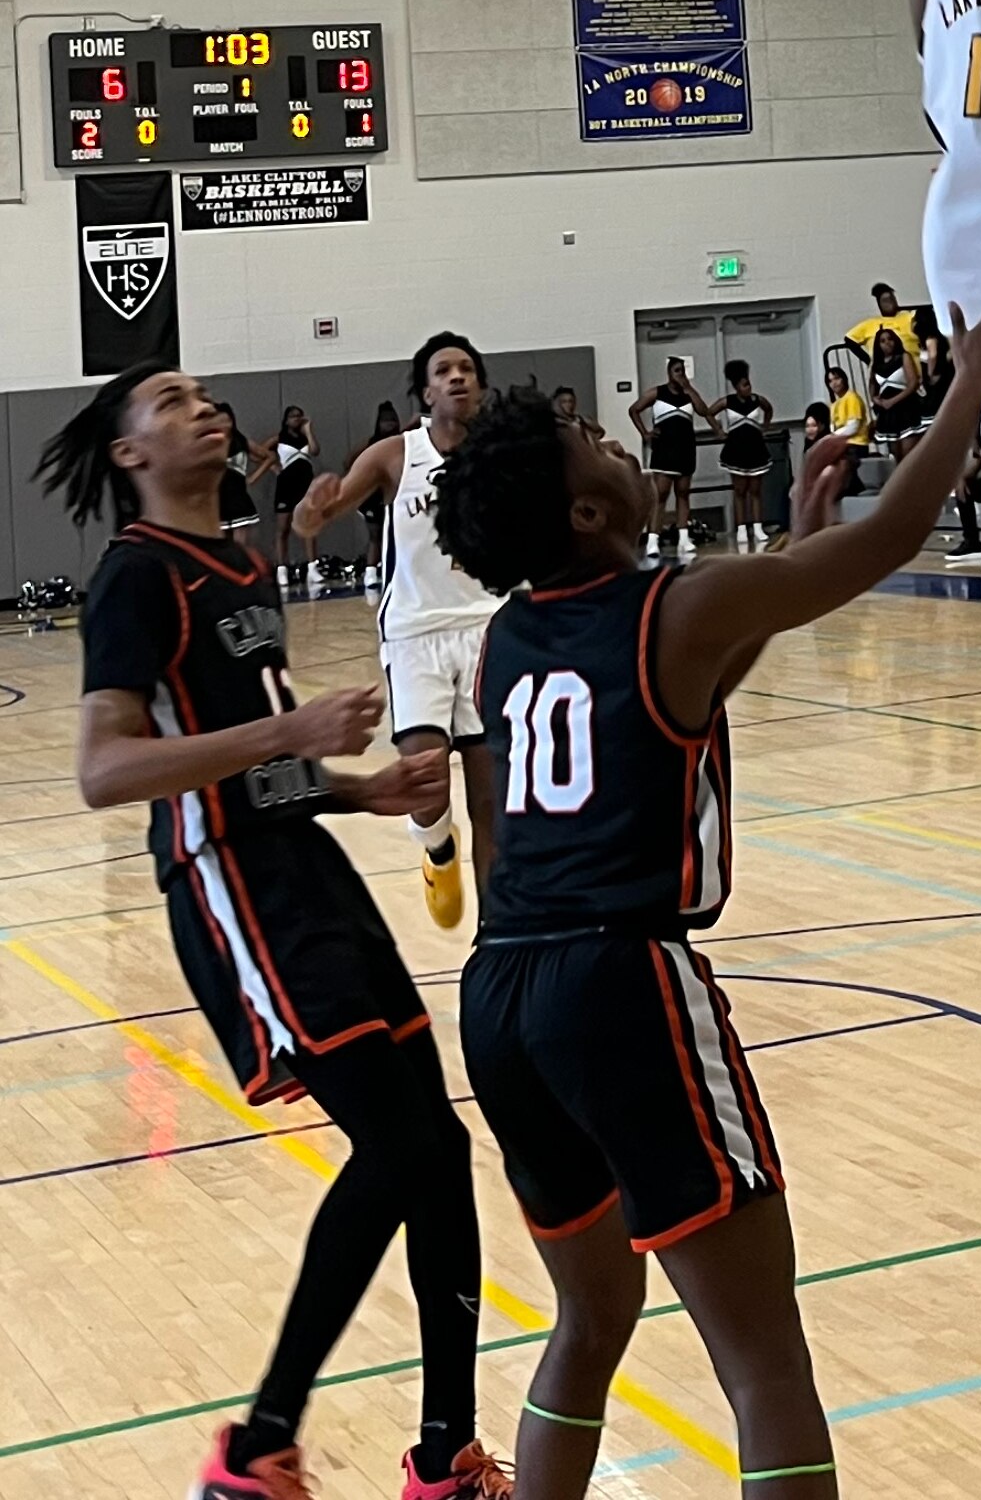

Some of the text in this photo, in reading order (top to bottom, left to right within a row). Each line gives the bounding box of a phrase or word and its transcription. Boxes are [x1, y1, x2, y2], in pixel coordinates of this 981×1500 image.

[68, 37, 126, 58] HOME
[205, 32, 271, 66] 1:03
[312, 30, 371, 50] GUEST
[102, 68, 125, 100] 6
[338, 60, 370, 91] 13
[584, 62, 743, 95] 1A NORTH CHAMPIONSHIP
[193, 83, 229, 94] PERIOD
[241, 77, 251, 98] 1
[625, 86, 706, 105] 20 19
[193, 103, 259, 115] PLAYER FOUL
[344, 98, 373, 109] FOULS
[70, 109, 102, 120] FOULS
[362, 113, 372, 133] 1
[611, 117, 672, 129] BASKETBALL
[675, 114, 743, 126] CHAMPIONSHIP
[81, 121, 98, 147] 2
[138, 120, 156, 145] 0
[291, 113, 310, 138] 0
[210, 142, 243, 153] MATCH
[345, 136, 375, 148] SCORE
[72, 149, 103, 160] SCORE
[220, 170, 327, 185] LAKE CLIFTON
[204, 180, 345, 200] BASKETBALL
[196, 202, 234, 211] TEAM
[252, 198, 299, 208] FAMILY
[315, 195, 353, 205] PRIDE
[213, 205, 338, 225] (#LENNONSTRONG)
[107, 263, 150, 292] HS
[405, 490, 438, 518] LAK
[502, 669, 595, 815] 10
